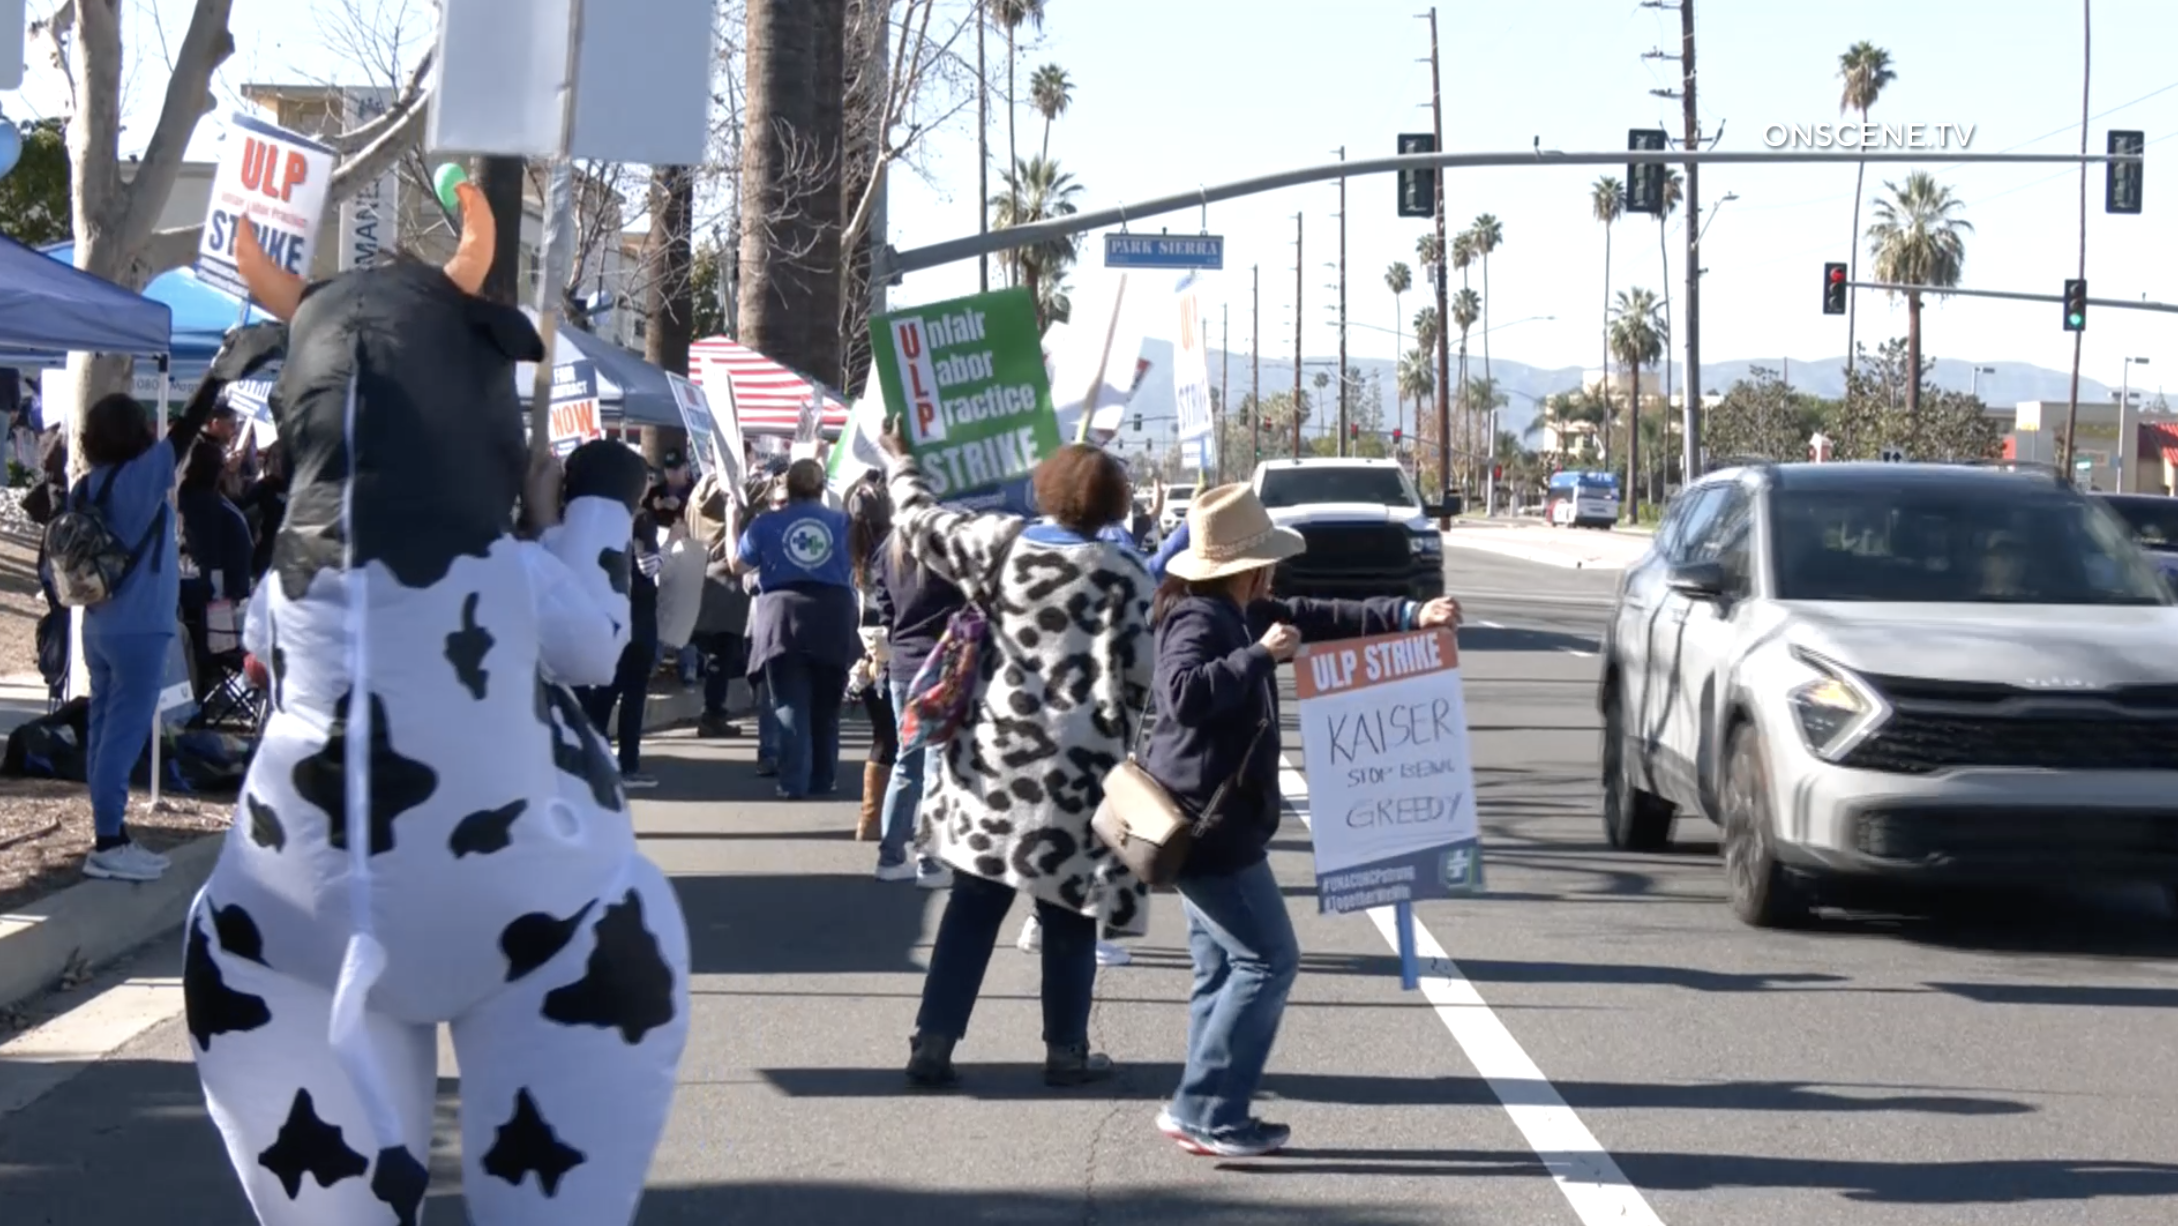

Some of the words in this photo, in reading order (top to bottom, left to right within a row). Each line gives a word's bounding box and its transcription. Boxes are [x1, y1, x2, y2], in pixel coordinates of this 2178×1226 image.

[241, 136, 308, 203] ULP
[1111, 239, 1152, 254] PARK
[1158, 241, 1218, 255] SIERRA
[551, 400, 594, 438] NOW
[922, 426, 1040, 494] STRIKE
[1311, 650, 1358, 692] ULP
[1364, 632, 1443, 681] STRIKE
[1328, 698, 1457, 765] KAISER
[1347, 766, 1393, 788] STOP
[1346, 792, 1462, 828] GREEDY
